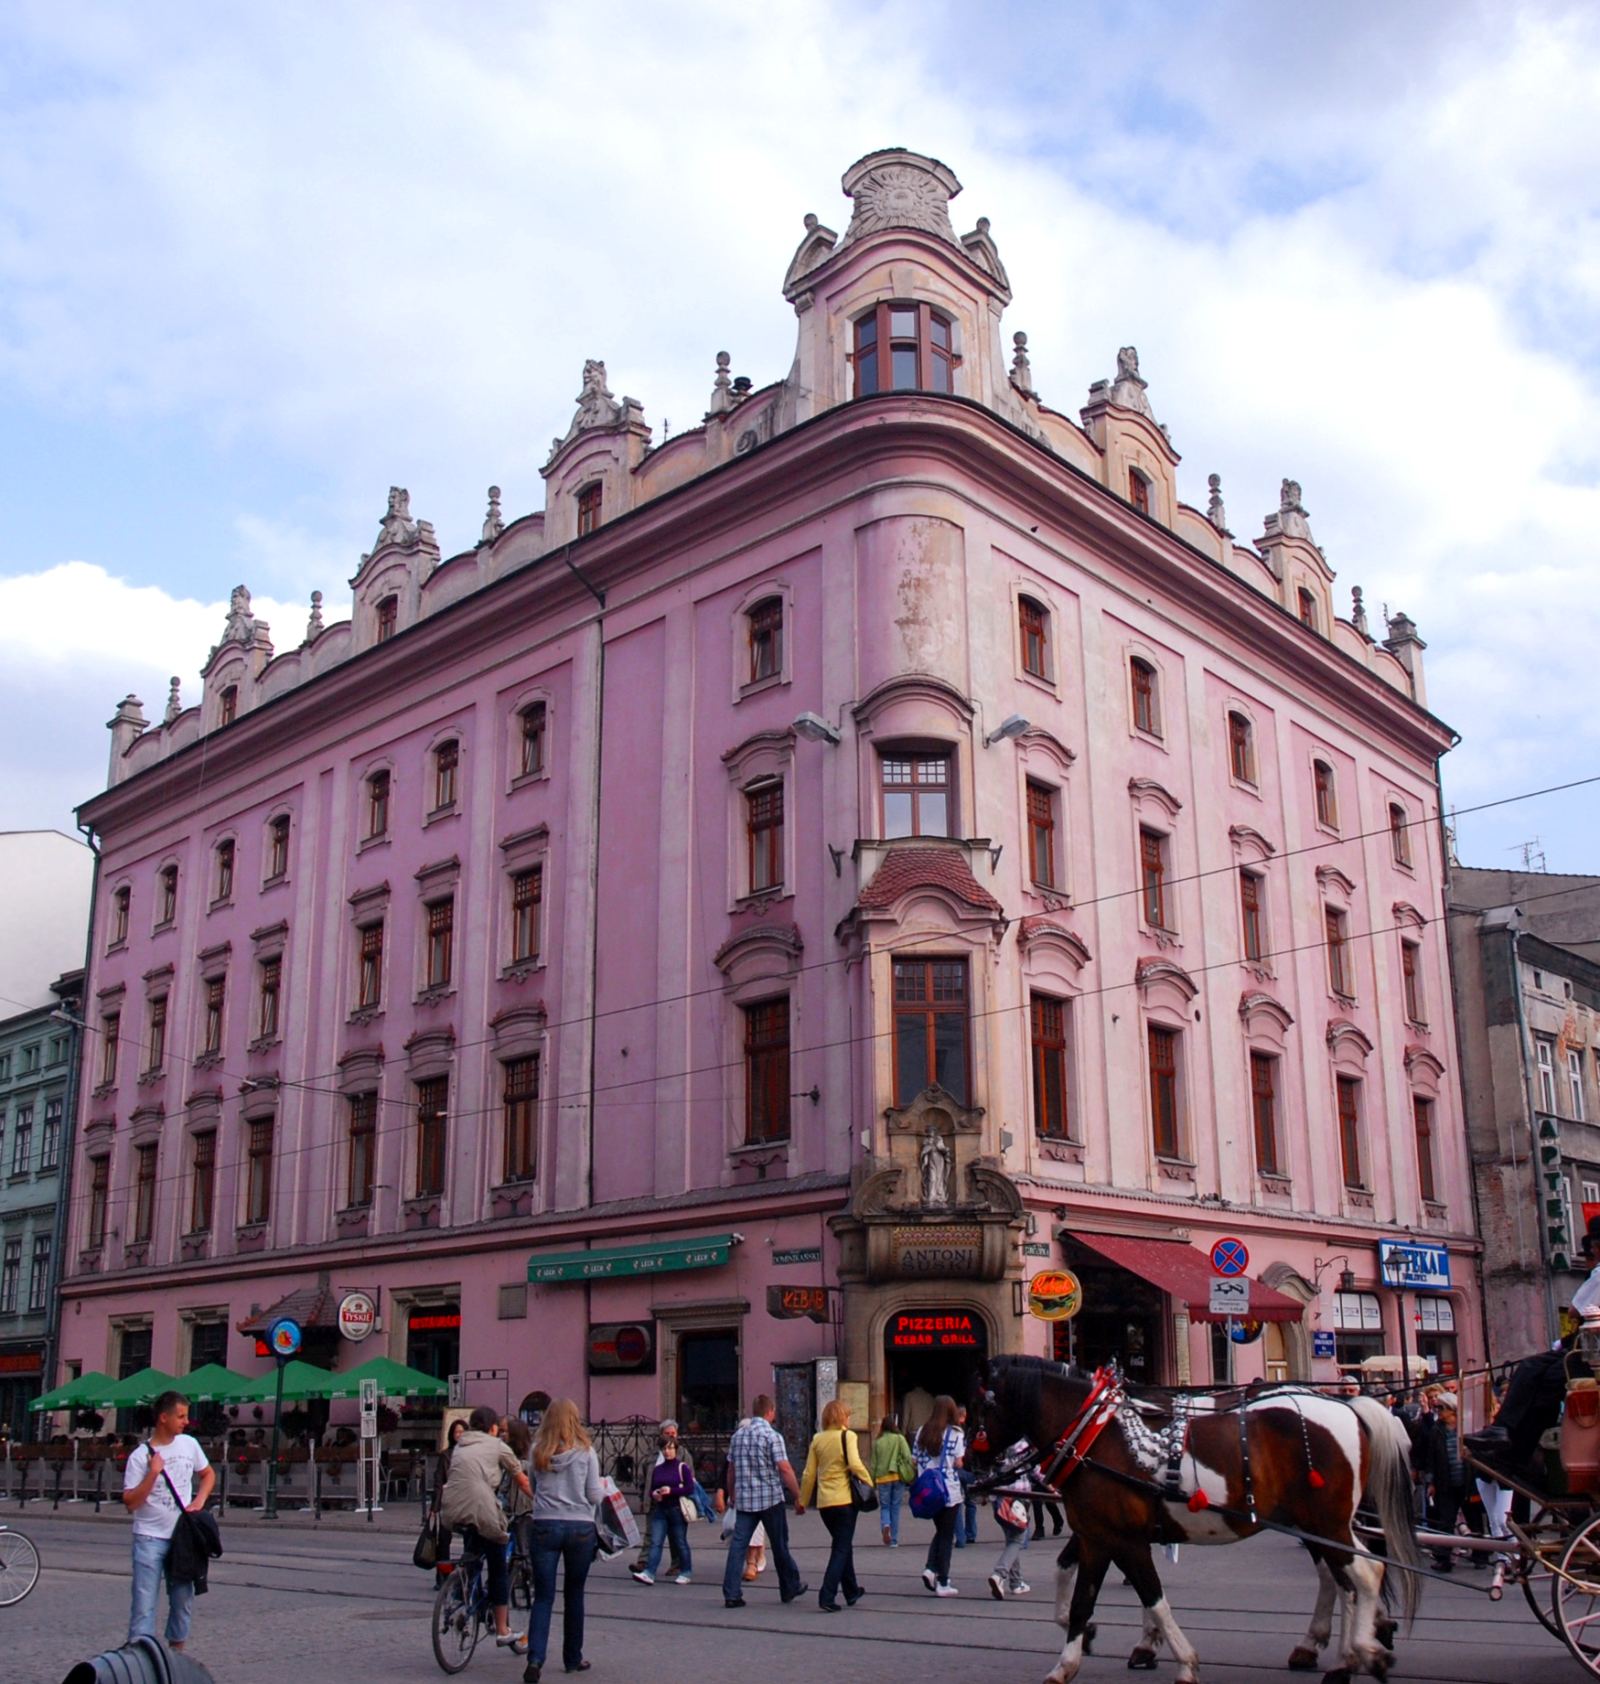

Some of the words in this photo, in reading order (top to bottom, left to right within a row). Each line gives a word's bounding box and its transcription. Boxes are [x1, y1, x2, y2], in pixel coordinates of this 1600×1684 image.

[1539, 1119, 1570, 1270] APTEKA
[903, 1249, 974, 1261] ANTONI
[902, 1261, 974, 1271] SUSKI
[344, 1312, 372, 1321] TYSKIE
[898, 1316, 972, 1330] PIZZERIA
[894, 1334, 934, 1345] KEBAB
[941, 1334, 977, 1345] GRILL
